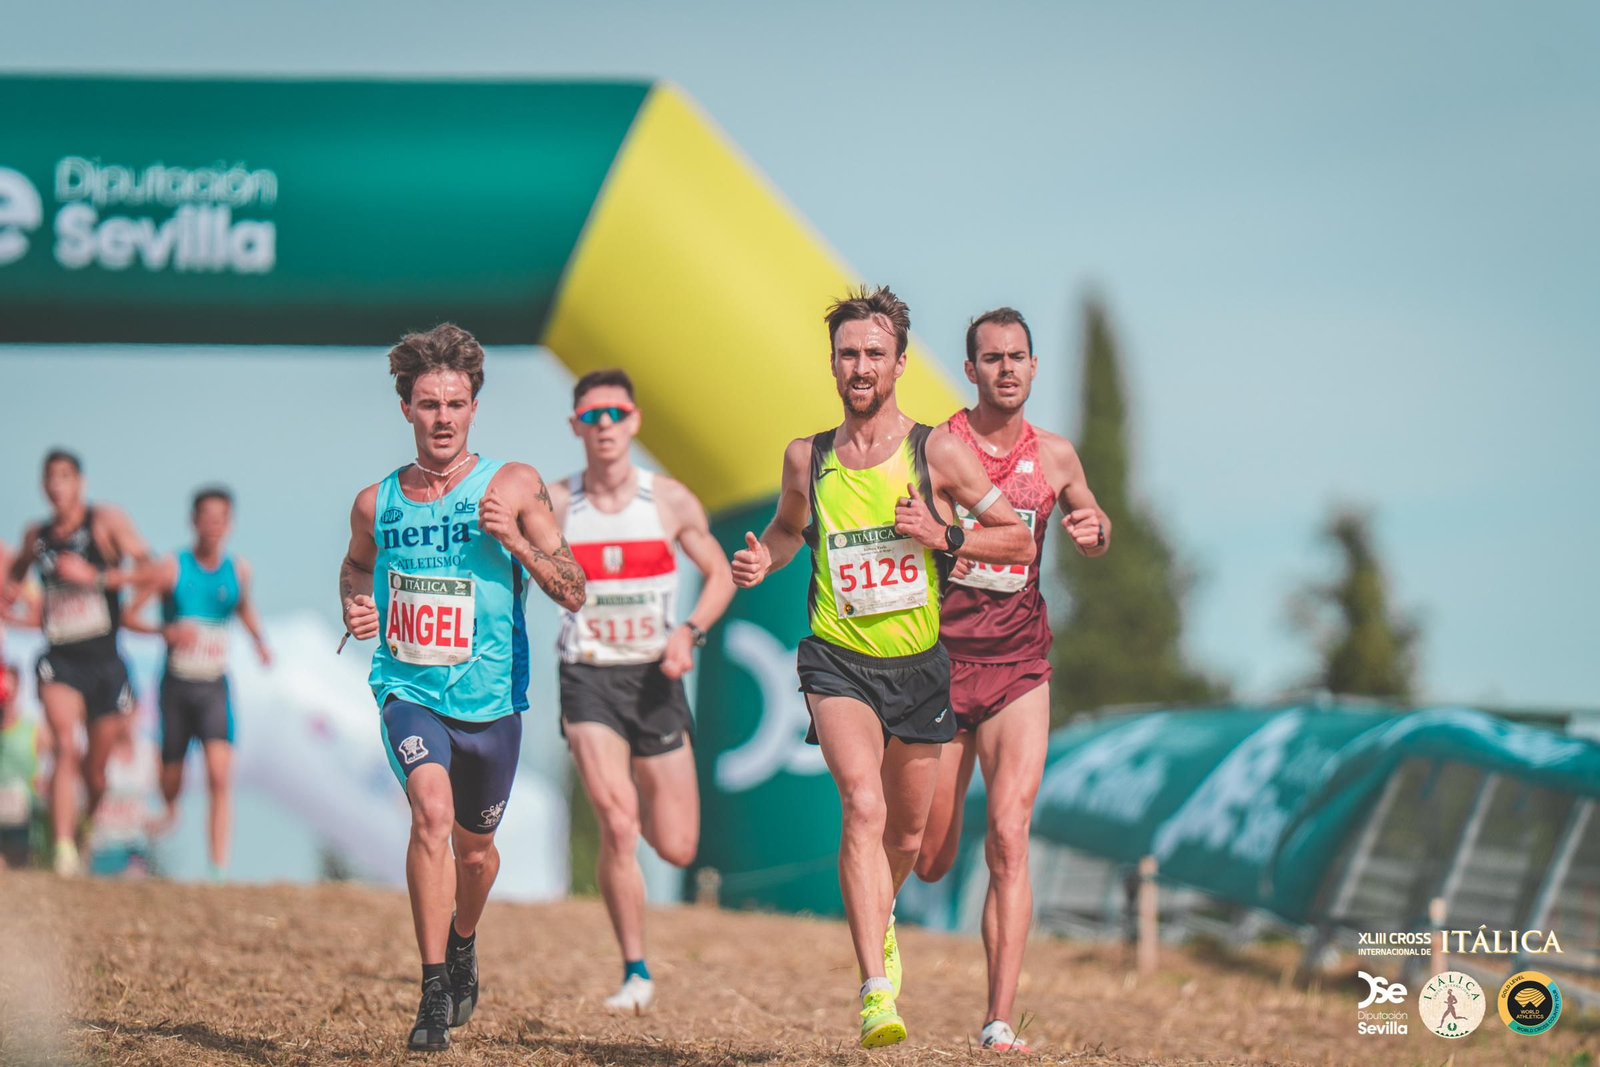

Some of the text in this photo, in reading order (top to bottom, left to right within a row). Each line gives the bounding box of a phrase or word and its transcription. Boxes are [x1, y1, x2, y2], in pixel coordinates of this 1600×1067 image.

[55, 156, 278, 207] Diputación
[54, 202, 277, 273] Sevilla
[382, 515, 472, 553] nerja
[852, 529, 896, 544] ITÁLICA
[396, 555, 461, 570] ATLETISMO
[839, 554, 919, 593] 5126
[405, 578, 448, 592] ITÁLICA
[387, 590, 469, 648] ÁNGEL
[586, 616, 656, 642] 5115
